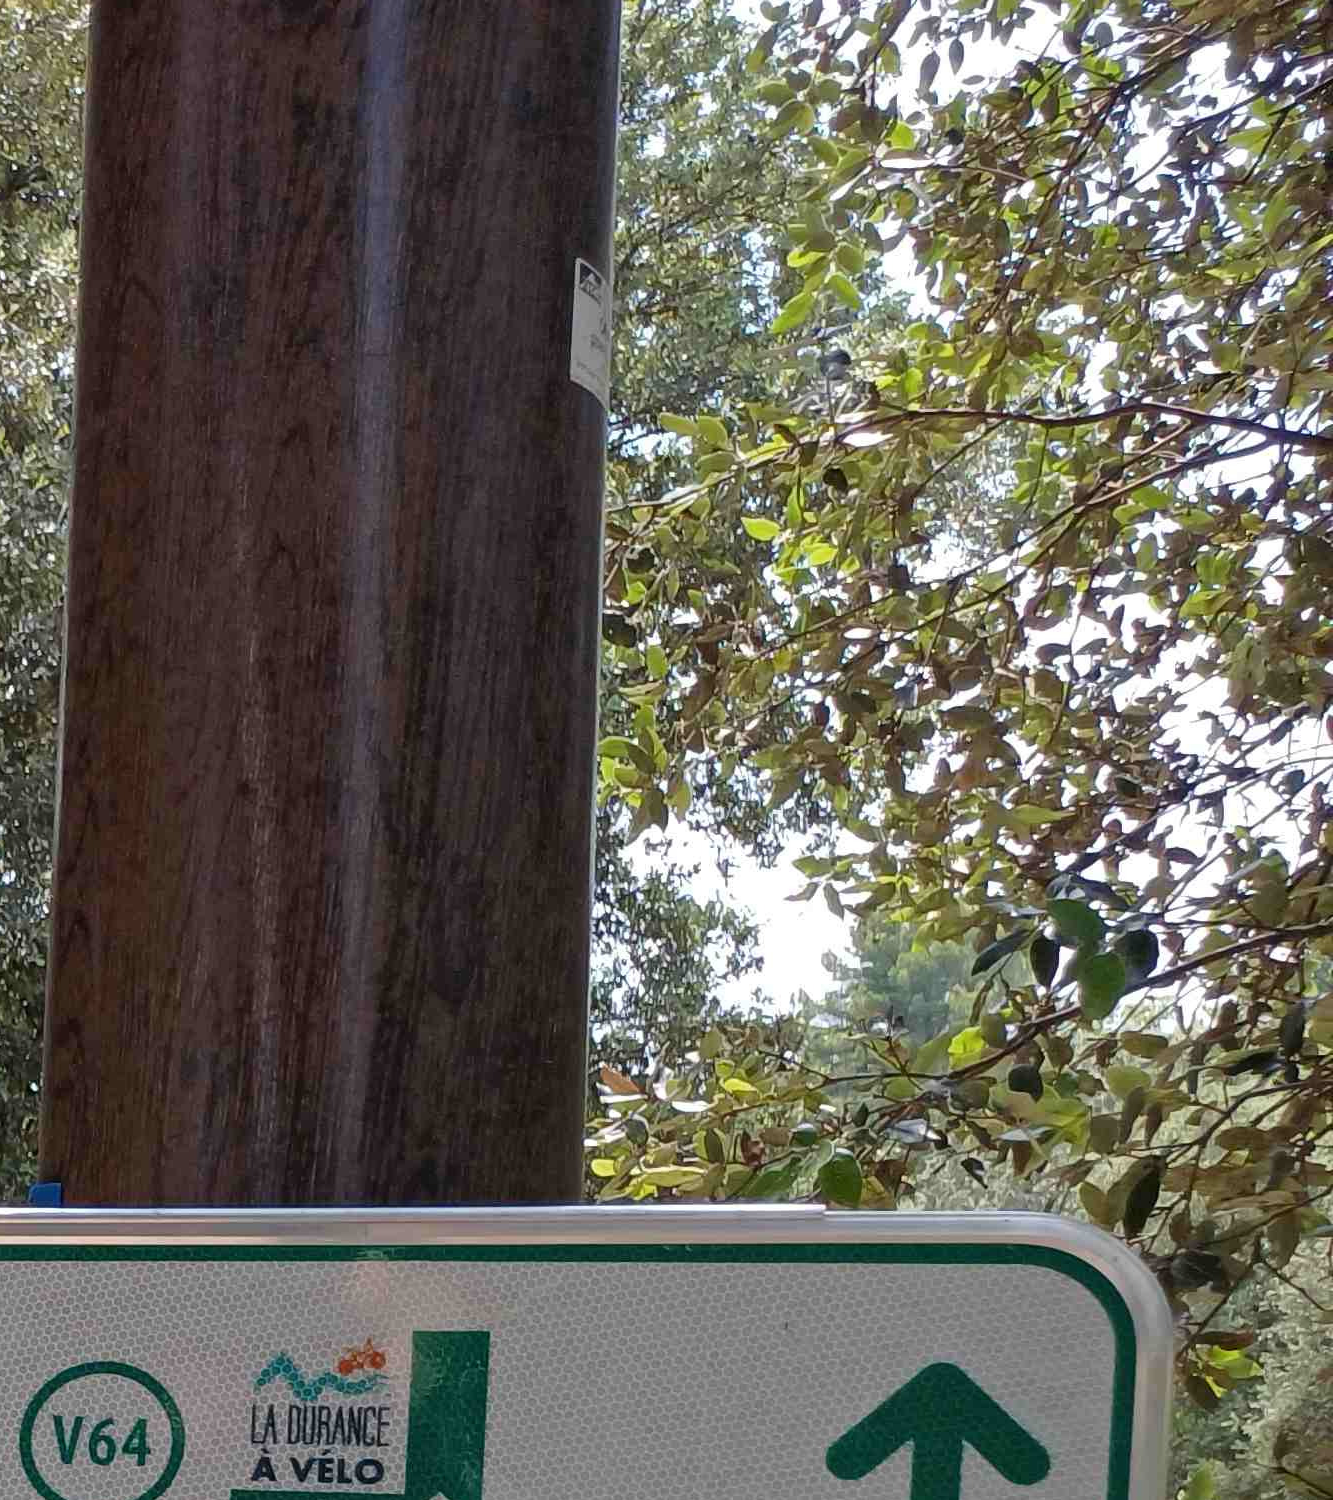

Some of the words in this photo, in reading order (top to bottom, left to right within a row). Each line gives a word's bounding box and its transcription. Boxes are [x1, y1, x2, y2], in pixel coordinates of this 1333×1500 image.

[52, 1415, 151, 1467] V64
[251, 1404, 277, 1444] LA
[287, 1405, 390, 1446] DURANCE
[251, 1448, 277, 1482] À
[289, 1449, 384, 1484] VÉLO
